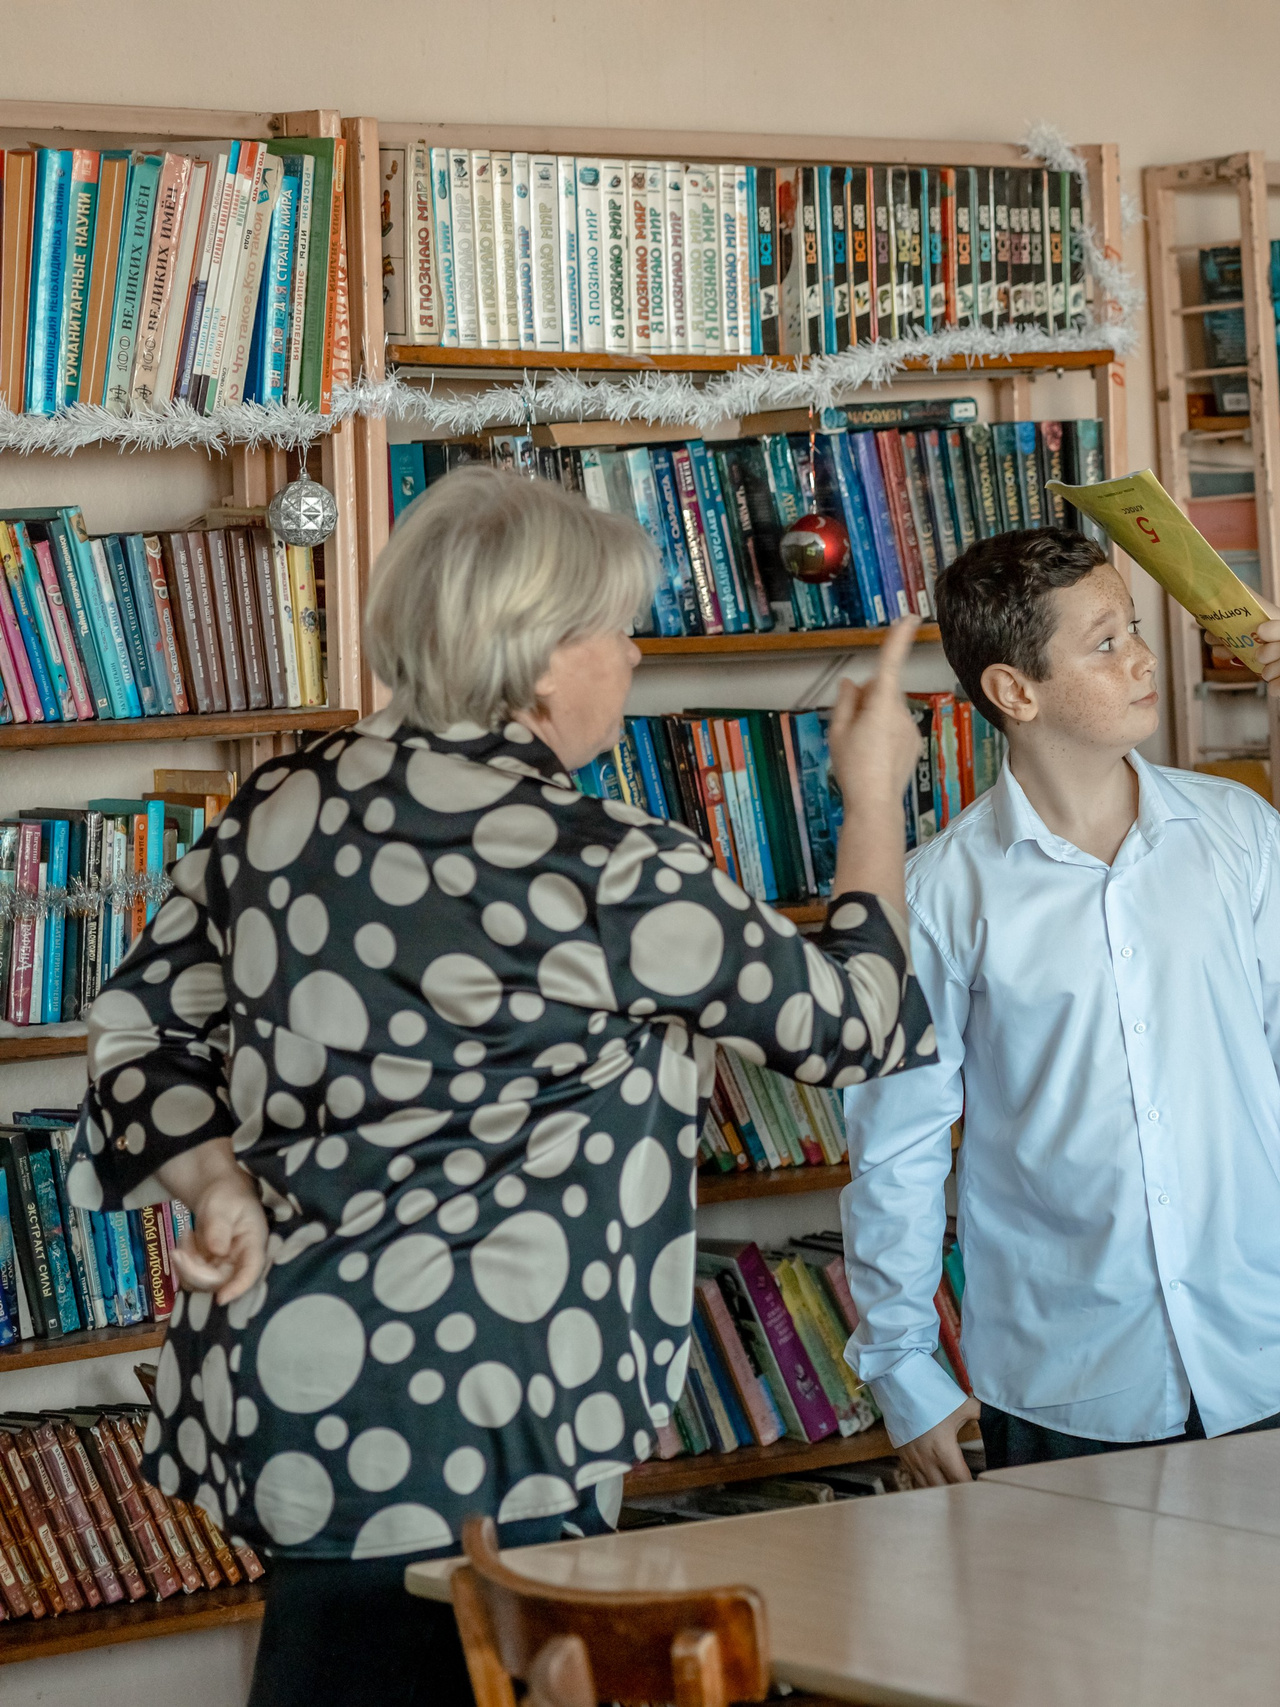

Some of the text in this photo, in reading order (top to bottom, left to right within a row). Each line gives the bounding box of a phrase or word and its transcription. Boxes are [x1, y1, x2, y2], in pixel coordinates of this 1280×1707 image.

[251, 151, 266, 202] ЧТО ЕСТЬ ЧТО
[205, 213, 217, 253] Константин
[248, 212, 264, 257] такой
[330, 195, 342, 236] КНИГА
[213, 236, 224, 264] СТРАНЫ
[244, 229, 253, 250] Вода
[299, 230, 307, 260] ИГРЫ
[416, 180, 434, 327] Я ПОЗНАЮ МИР
[517, 226, 529, 259] МИР
[760, 233, 772, 265] ВСЕ
[805, 232, 817, 264] ВСЕ
[835, 232, 845, 263] ВСЕ
[855, 231, 866, 262] ВСЕ
[878, 232, 888, 263] ВСЕ
[932, 233, 941, 264] ВСЕ
[958, 233, 970, 264] ВСЕ
[981, 231, 991, 262] ВСЕ
[1051, 233, 1061, 263] ВСЕ
[47, 229, 62, 312] НЕОБХОДИМЫХ
[117, 184, 150, 371] 100 ВЕЛИКИХ ИМЁН
[147, 246, 169, 332] ВЕЛИКИХ
[159, 187, 177, 239] ИМЁН
[328, 240, 339, 293] ЗНАНИЙ
[539, 202, 556, 329] Я ПОЗНАЮ МИР
[585, 208, 600, 326] Я ПОЗНАЮ МИР
[608, 198, 624, 339] Я ПОЗНАЮ МИР
[634, 200, 650, 339] Я ПОЗНАЮ МИР
[649, 207, 664, 333] Я ПОЗНАЮ МИР
[702, 203, 719, 340] Я ПОЗНАЮ МИР
[724, 213, 739, 337] Я ПОЗНАЮ МИР
[65, 193, 91, 386] ГУМАНИТАРНЫЕ НАУКИ
[270, 189, 293, 388] ЭНЦИКЛОПЕДИЯ СТРАНЫ МИРА
[519, 263, 533, 329] ПОЗНАЮ
[190, 300, 203, 334] тропами
[293, 270, 305, 361] ЭНЦИКЛОПЕДИЯ
[44, 316, 57, 402] ЭНЦИКЛОПЕДИЯ
[231, 345, 247, 374] Что
[228, 383, 240, 401] 2
[1121, 504, 1144, 515] класс
[707, 509, 724, 560] БУСЛАЕВ
[1135, 516, 1160, 544] 5
[67, 572, 83, 609] пишущей
[117, 563, 129, 593] ВДОВЫ
[77, 610, 90, 637] Тайна
[124, 596, 138, 631] ЧЕРНОЙ
[133, 633, 146, 671] ЗАГАДКА
[31, 831, 40, 864] Евгений
[137, 835, 145, 866] ШЛЯПЕ
[26, 1202, 52, 1298] ЭКСТРАКТ СИЛЫ
[119, 1235, 131, 1274] КОШКИ
[146, 1242, 167, 1308] МЕФОДИЙ
